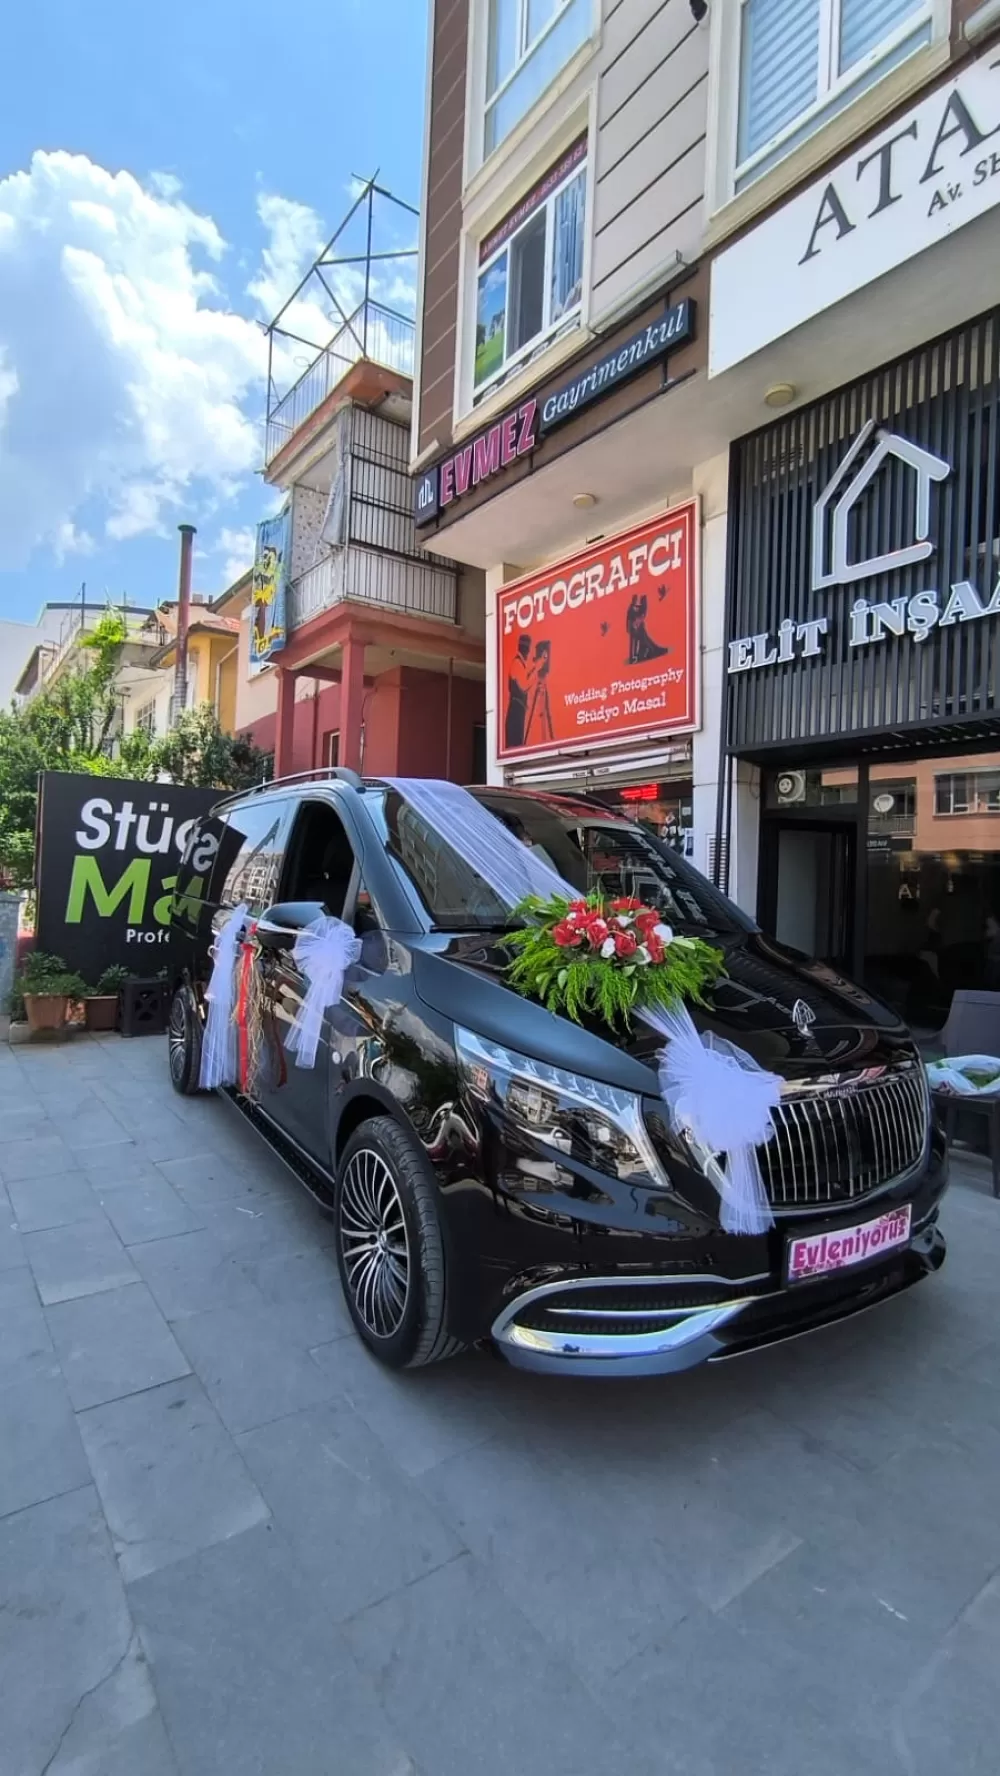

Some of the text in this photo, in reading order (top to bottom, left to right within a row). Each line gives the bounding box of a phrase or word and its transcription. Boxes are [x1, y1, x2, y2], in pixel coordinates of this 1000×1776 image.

[798, 60, 1000, 265] ATA
[927, 182, 963, 217] Av.
[440, 303, 685, 508] EVMEZ Gayrimenkul
[503, 529, 683, 635] FOTOGRAFCI
[727, 618, 828, 673] ELİT
[564, 667, 684, 707] Wedding Photography
[623, 691, 667, 716] Masal
[793, 1216, 907, 1270] Evleniyoruz
